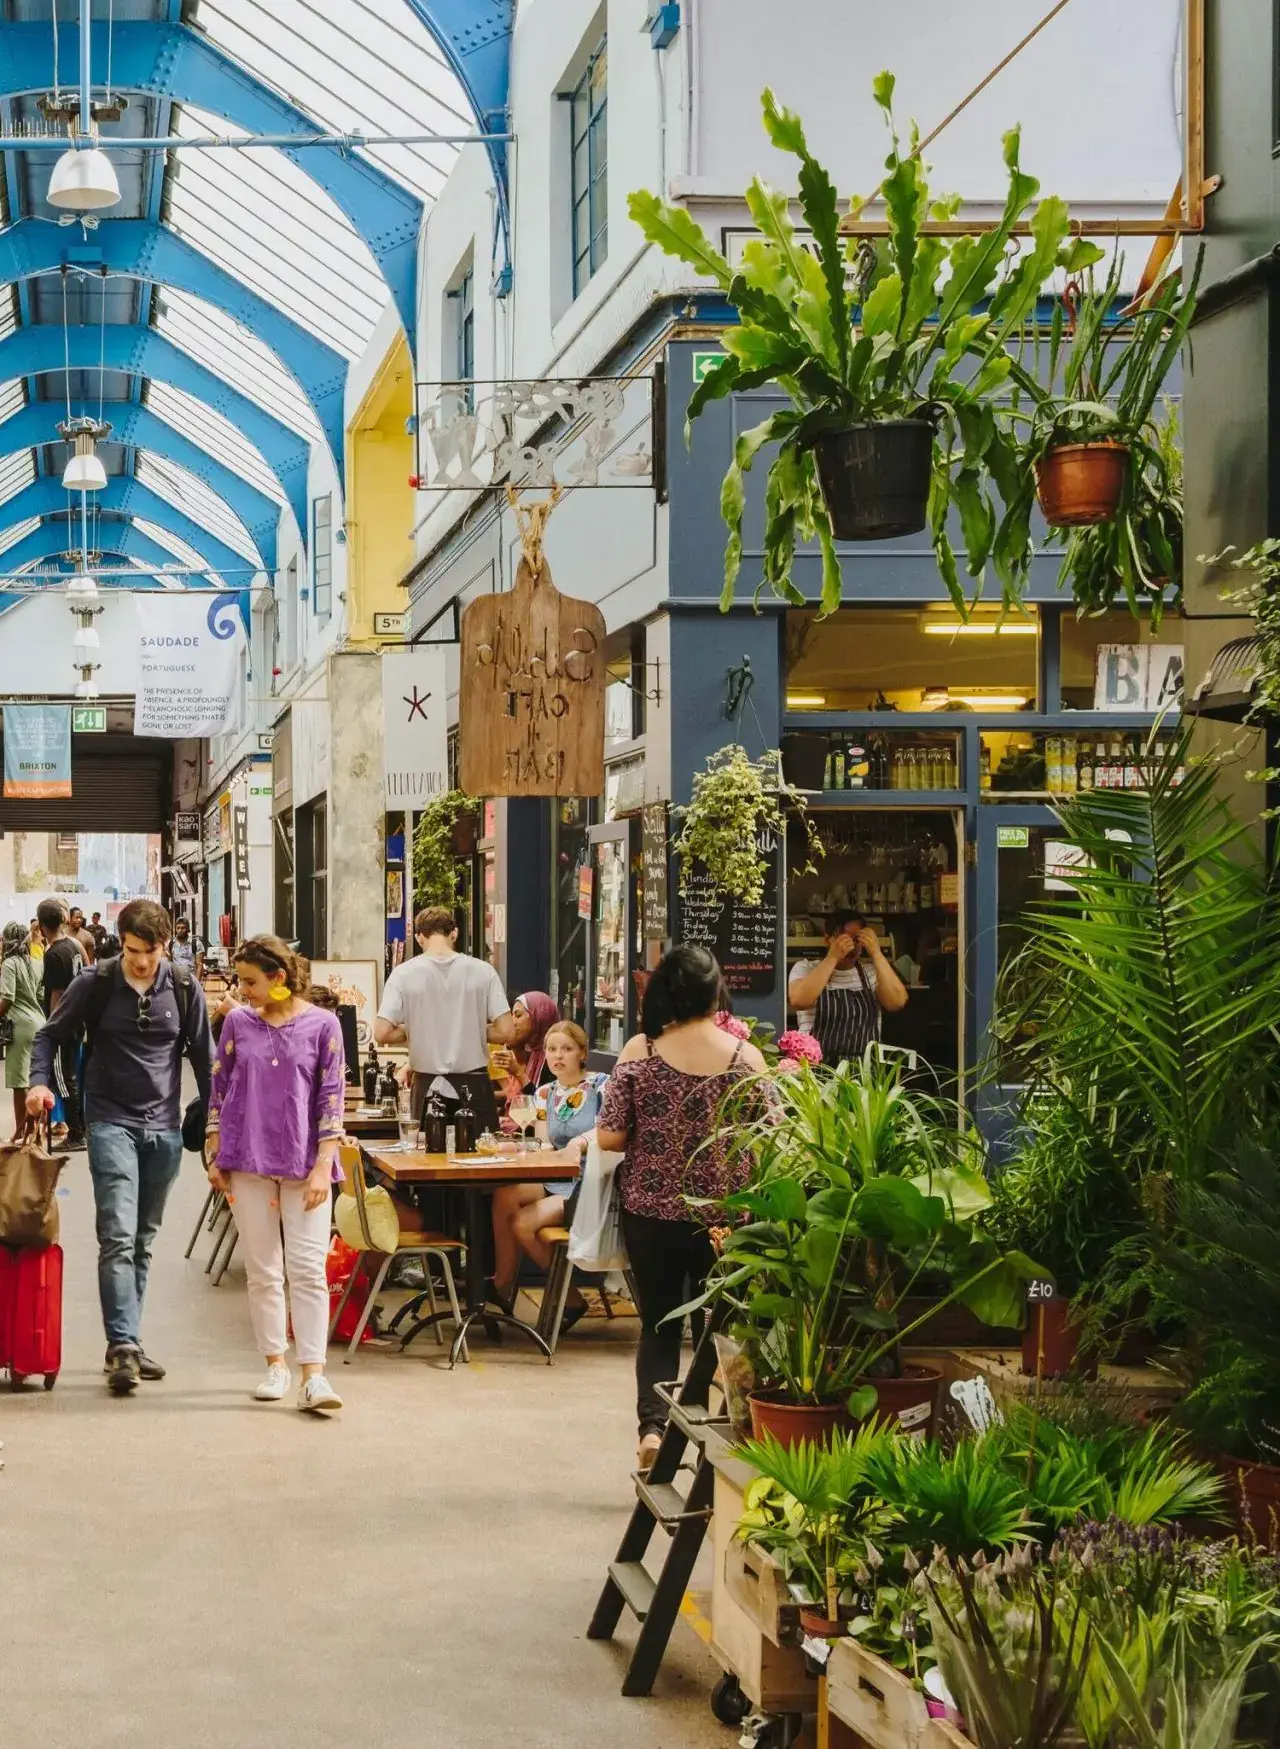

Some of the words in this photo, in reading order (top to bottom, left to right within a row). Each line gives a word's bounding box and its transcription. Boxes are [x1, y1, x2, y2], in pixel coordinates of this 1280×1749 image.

[140, 636, 200, 647] SAUDADE
[142, 664, 196, 672] PORTUGUESE
[183, 696, 230, 704] PROFOUNDLY
[19, 762, 57, 770] BRIXTON
[236, 811, 246, 873] WINE
[681, 907, 720, 923] Thursday
[683, 918, 708, 933] Friday
[682, 929, 718, 944] Saturday
[1028, 1280, 1053, 1297] £10
